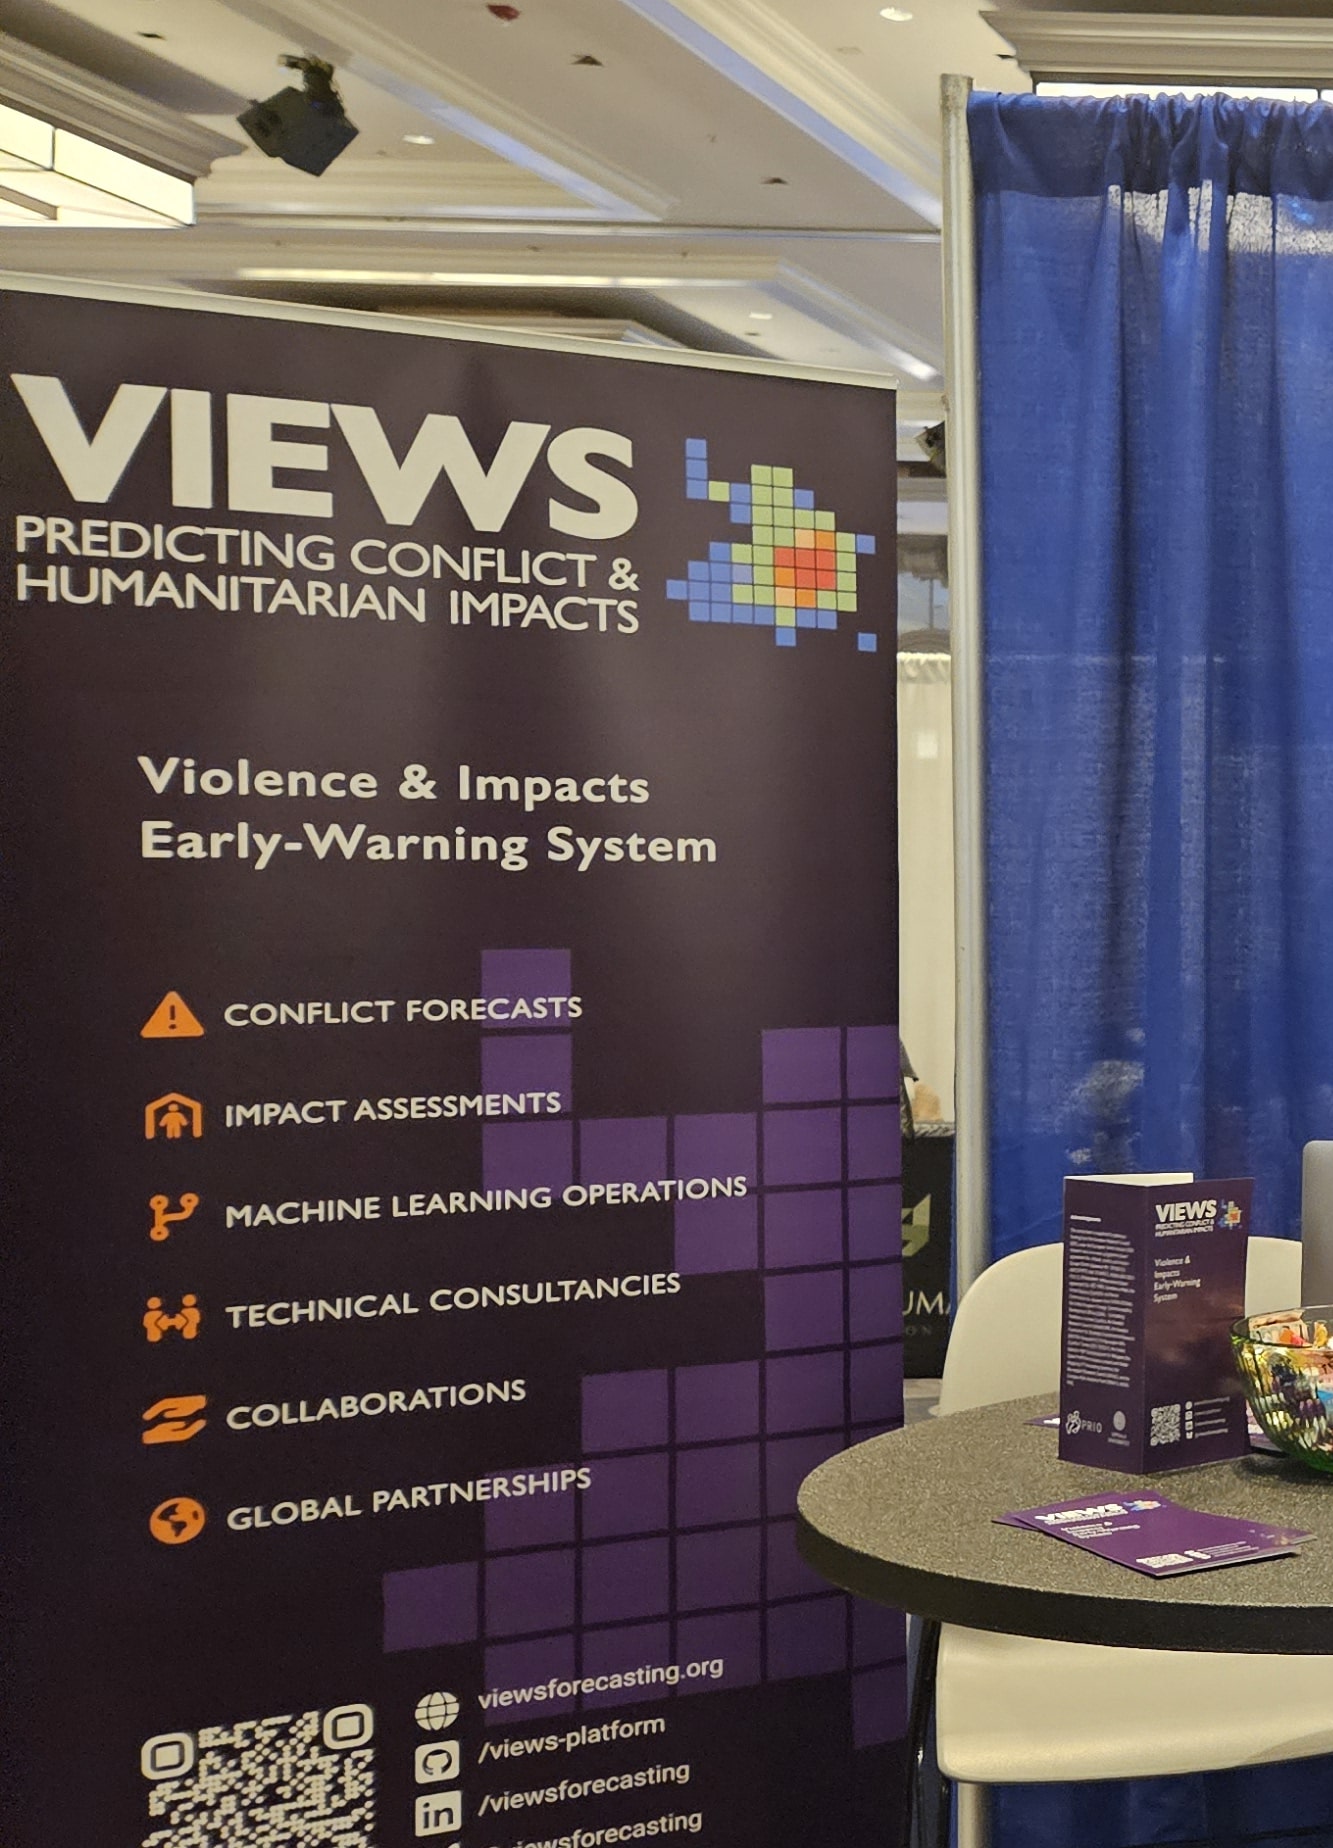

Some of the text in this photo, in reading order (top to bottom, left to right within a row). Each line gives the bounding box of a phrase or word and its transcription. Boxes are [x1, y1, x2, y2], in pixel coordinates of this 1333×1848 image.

[11, 373, 638, 539] VIEWS
[17, 516, 639, 591] PREDICTING CONFLICT &
[16, 565, 639, 634] HUMANITARIAN IMPACTS
[138, 756, 649, 811] Violence & Impacts
[142, 821, 716, 871] Early-Warning System
[225, 997, 582, 1026] CONFLICT FORECASTS
[226, 1092, 561, 1127] IMPACT ASSESSMENTS
[227, 1176, 746, 1228] MACHINE LEARNING OPERATIONS
[1155, 1200, 1217, 1222] VIEWS
[225, 1273, 680, 1328] TECHNICAL CONSULTANCIES
[227, 1380, 525, 1429] COLLABORATIONS
[227, 1468, 591, 1530] GLOBAL PARTNERSHIPS
[478, 1659, 723, 1709] viewsforecasting.org
[478, 1718, 665, 1763] /views-platform
[478, 1765, 689, 1817] /viewsforecasting
[492, 1812, 703, 1848] ewsforecasting
